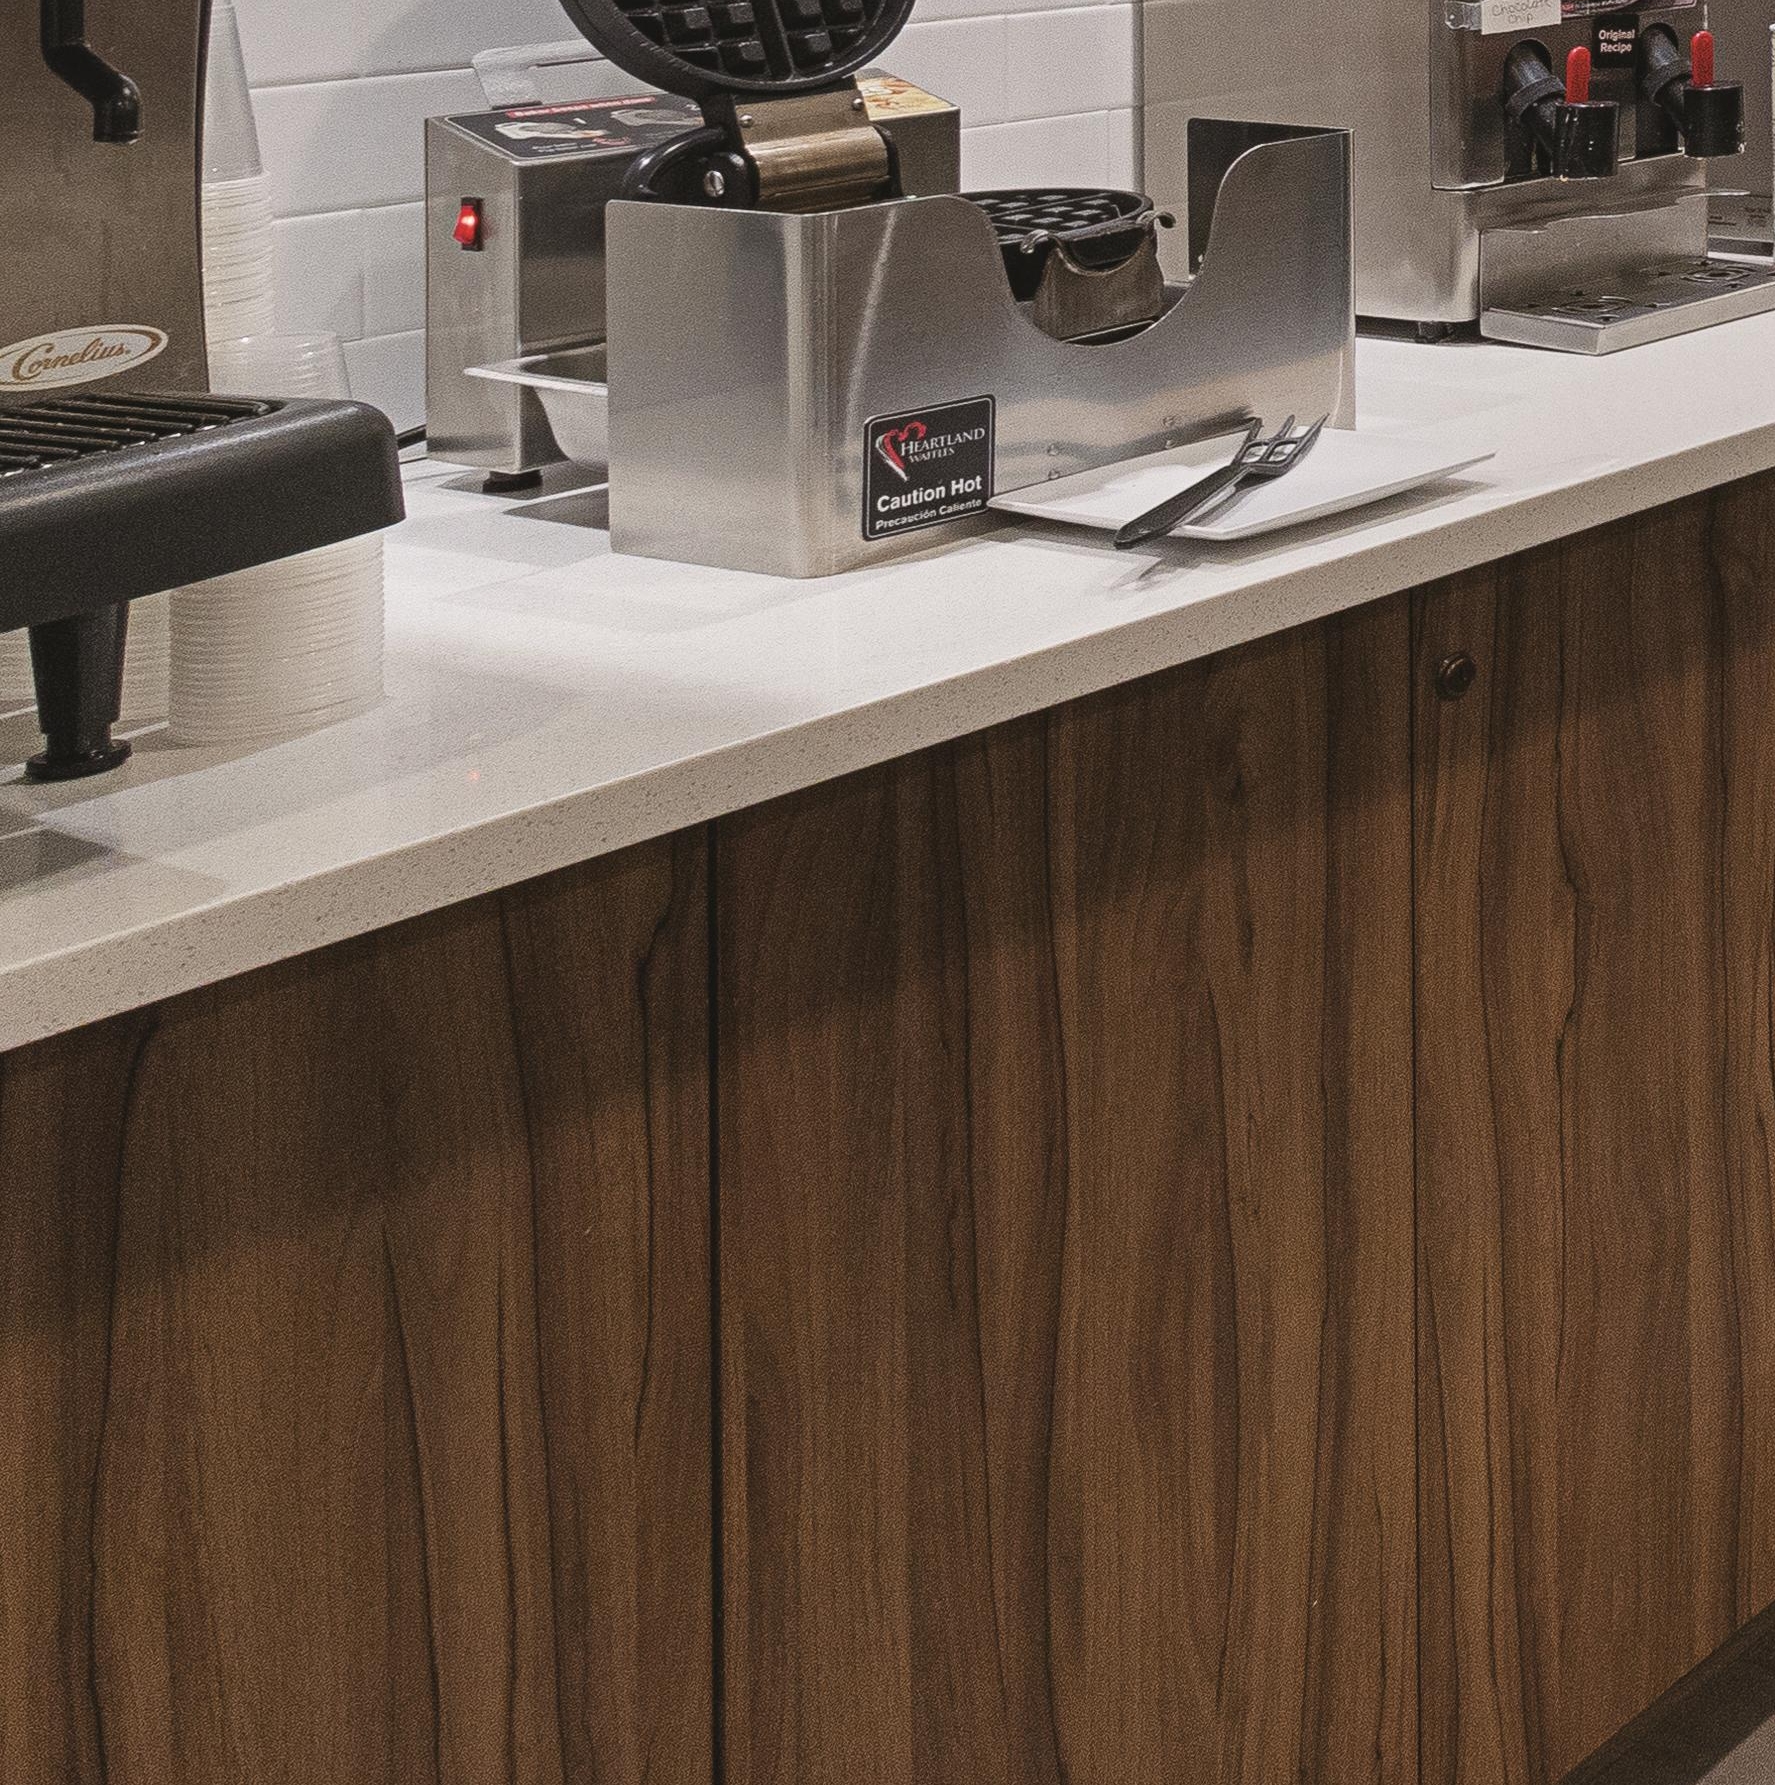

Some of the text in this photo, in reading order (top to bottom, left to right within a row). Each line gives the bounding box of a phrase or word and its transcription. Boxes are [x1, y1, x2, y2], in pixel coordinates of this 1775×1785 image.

[1598, 29, 1635, 41] Original
[1600, 42, 1632, 54] Recipe
[12, 337, 125, 381] Cornelius
[901, 427, 986, 456] HEARTLAND
[877, 475, 983, 512] Caution Hot
[875, 498, 982, 530] Precaución Caliente
